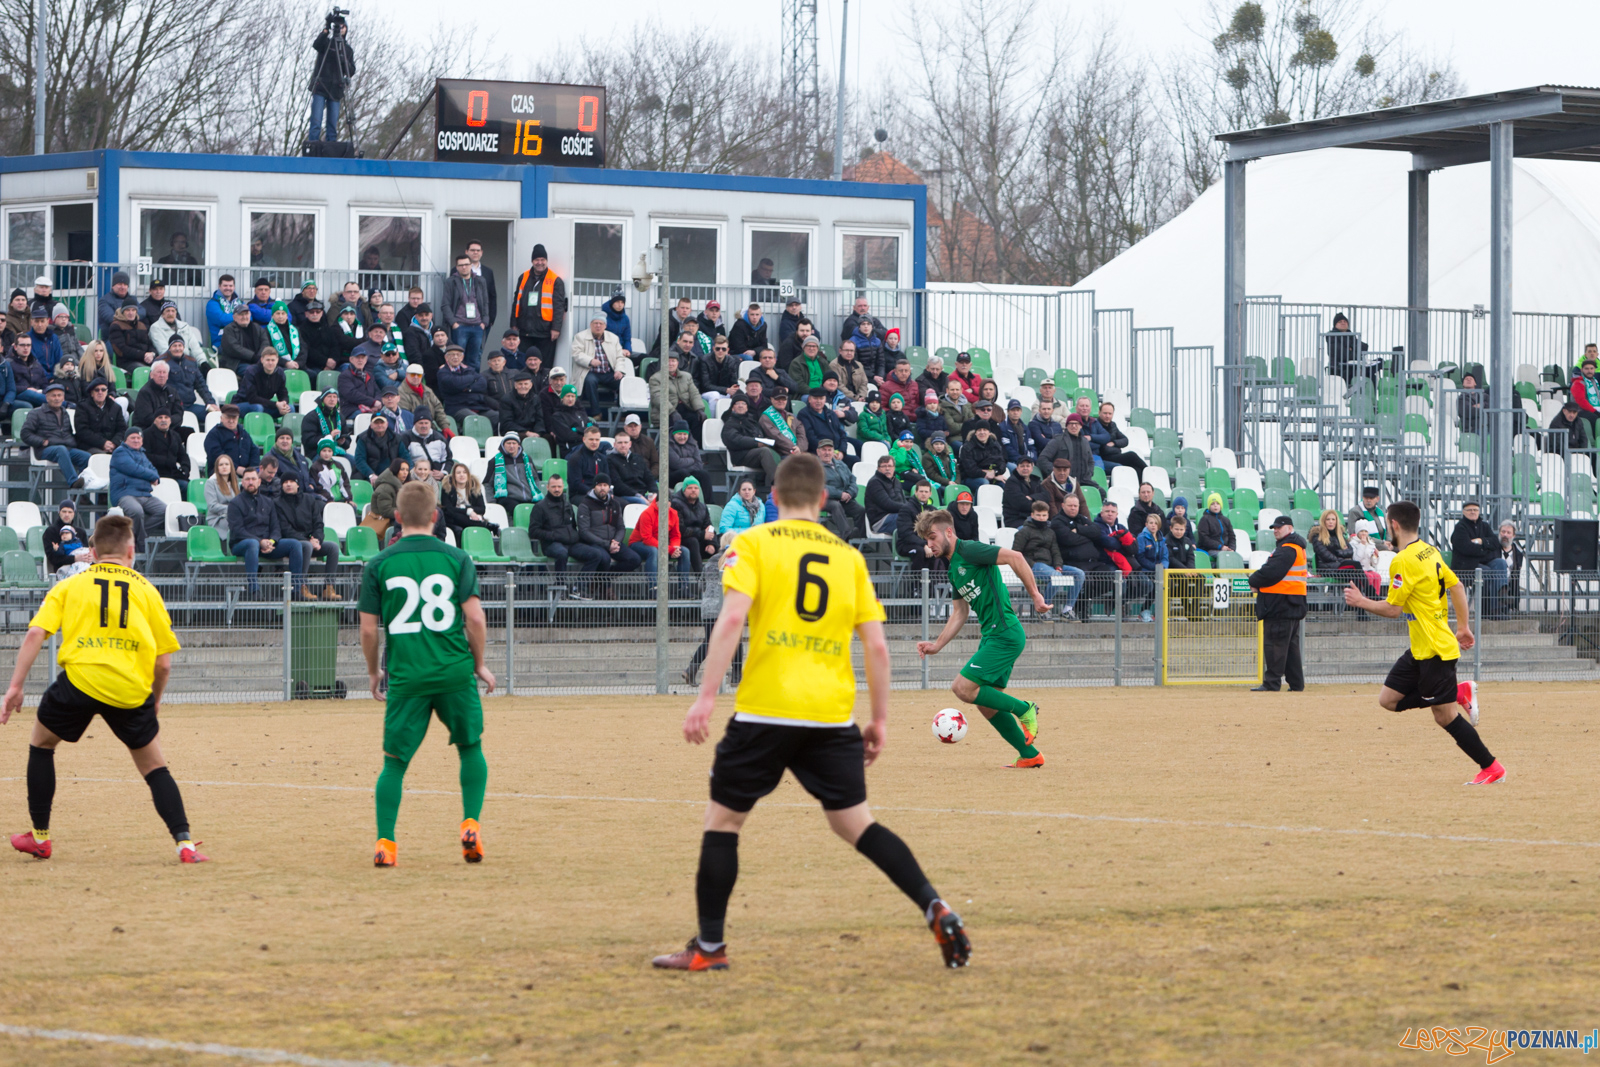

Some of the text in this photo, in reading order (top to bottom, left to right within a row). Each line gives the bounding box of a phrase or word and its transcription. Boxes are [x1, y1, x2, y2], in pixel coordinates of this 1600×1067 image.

[466, 90, 489, 127] 0
[511, 94, 535, 113] CZAS
[577, 95, 599, 132] 0
[437, 131, 499, 152] GOSPODARZE
[513, 119, 543, 156] 16
[561, 133, 594, 156] GOŚCIE
[138, 263, 150, 272] 31
[781, 285, 793, 294] 30
[1474, 309, 1484, 317] 29
[795, 552, 829, 622] 6
[1215, 584, 1228, 603] 33
[94, 578, 130, 629] 11
[385, 573, 456, 635] 28
[76, 637, 140, 652] SAN-TECH
[766, 630, 843, 656] SAN-TECH
